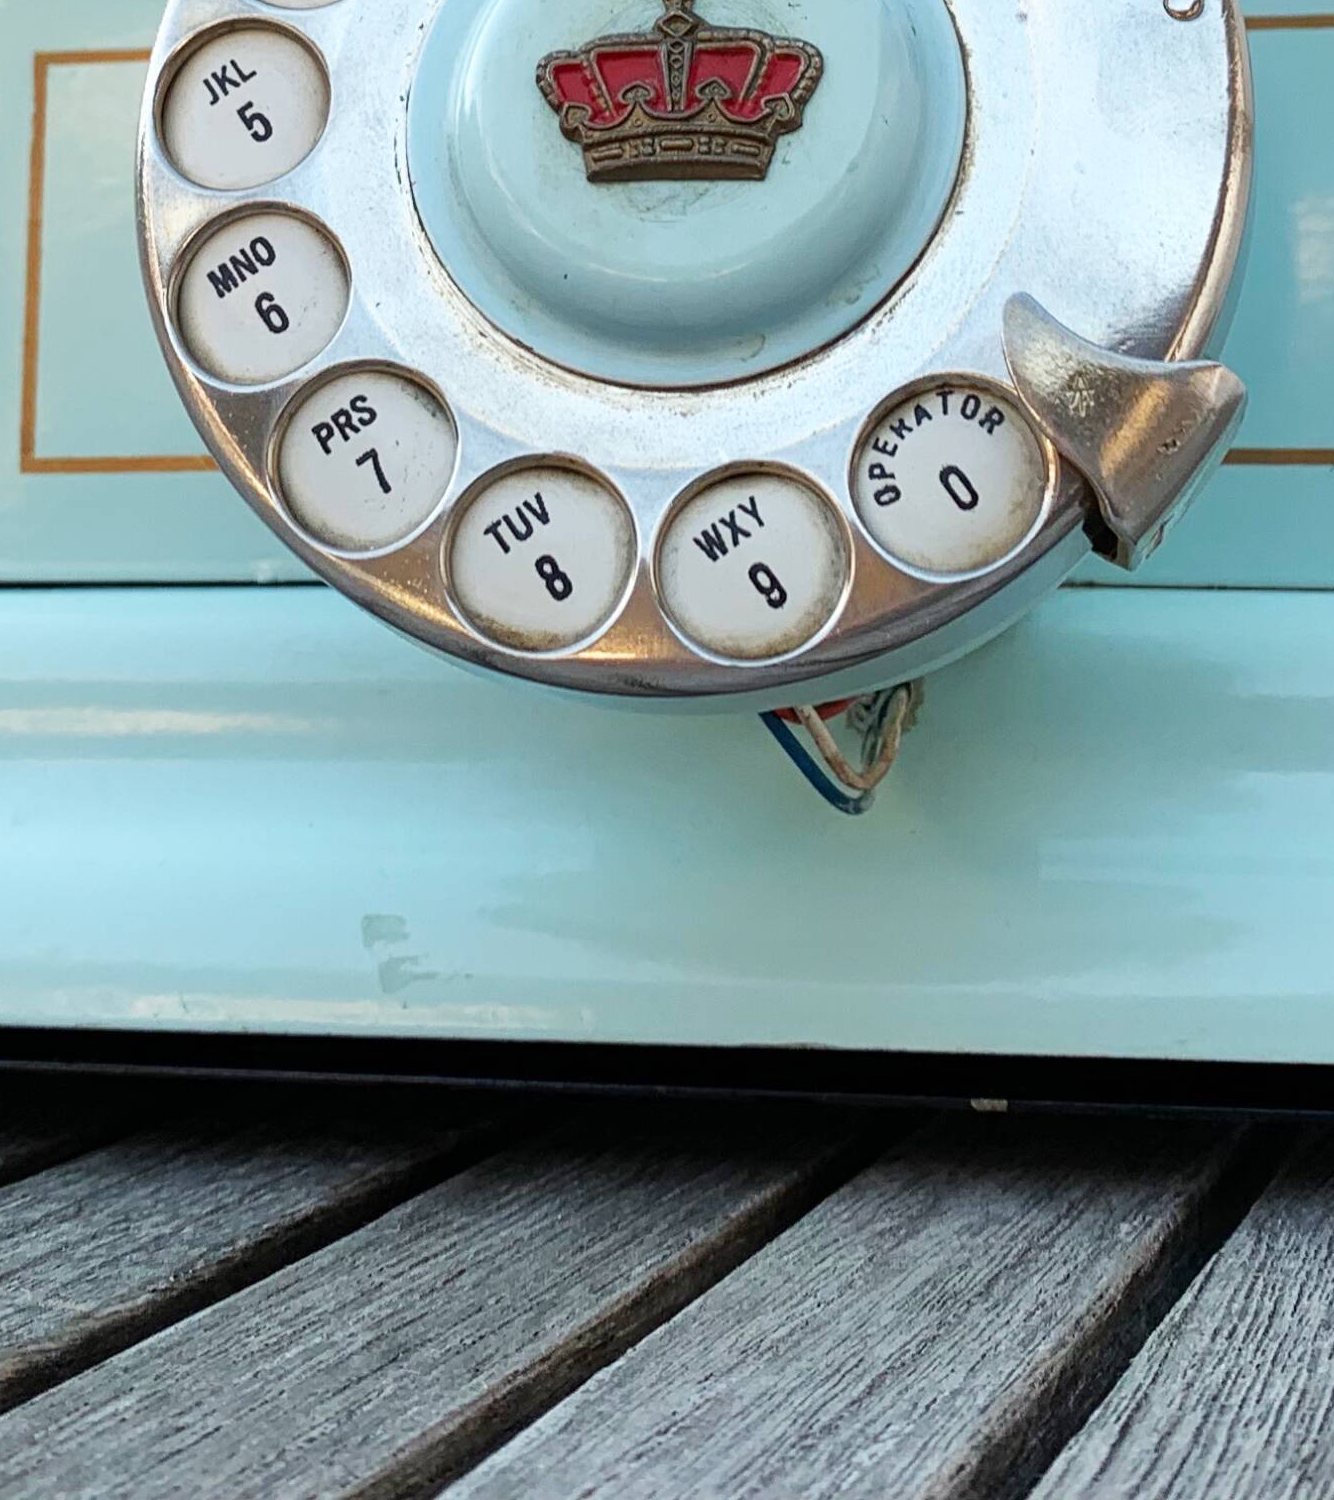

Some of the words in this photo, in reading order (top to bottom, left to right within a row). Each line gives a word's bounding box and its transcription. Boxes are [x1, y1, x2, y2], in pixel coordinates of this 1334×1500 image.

[202, 58, 257, 107] JKL
[236, 100, 273, 143] 5
[206, 235, 277, 299] MNO
[254, 291, 290, 334] 6
[311, 393, 379, 455] PRS
[355, 447, 392, 494] 7
[938, 465, 980, 512] 0
[482, 491, 552, 555] TUV
[692, 495, 768, 562] WXY
[534, 554, 573, 602] 8
[747, 562, 788, 610] 9
